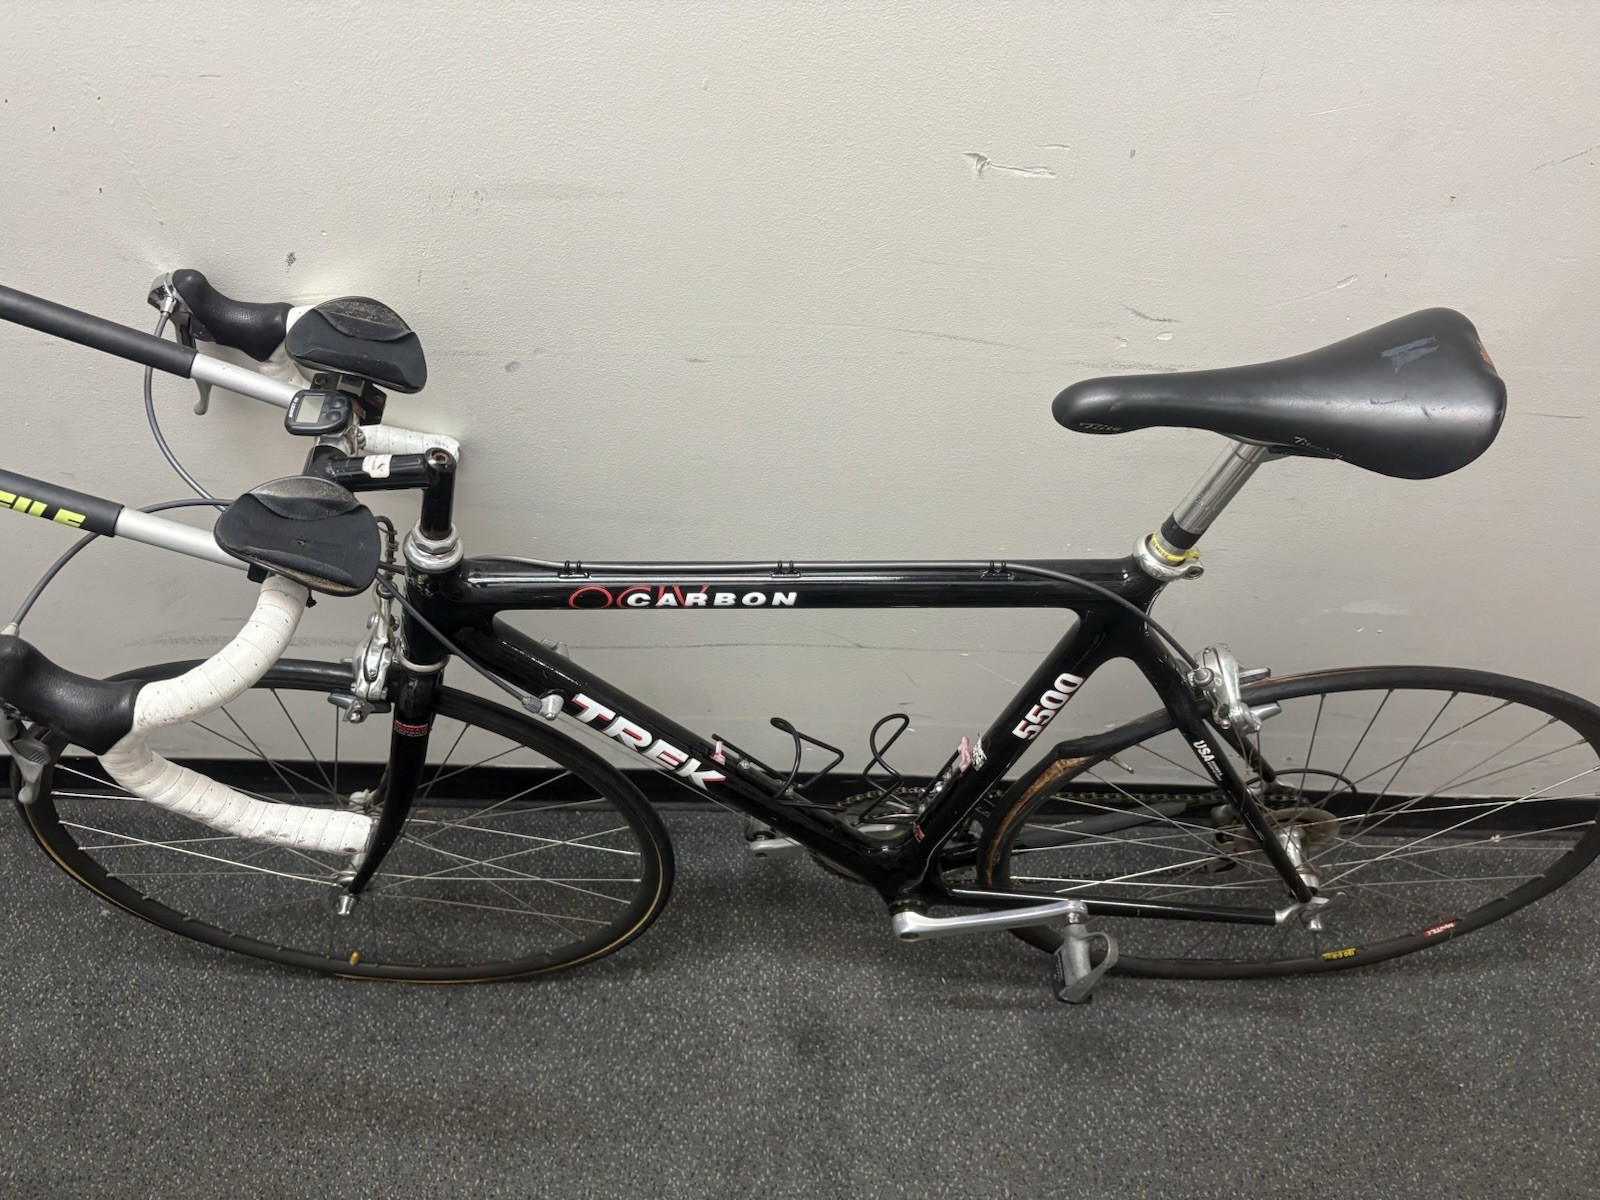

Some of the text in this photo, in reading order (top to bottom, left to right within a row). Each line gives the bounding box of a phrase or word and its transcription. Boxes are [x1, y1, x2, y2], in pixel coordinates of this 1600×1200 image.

[626, 592, 798, 607] CARBON
[1011, 672, 1086, 741] 5500
[571, 692, 727, 791] TREK
[1192, 740, 1216, 763] USA
